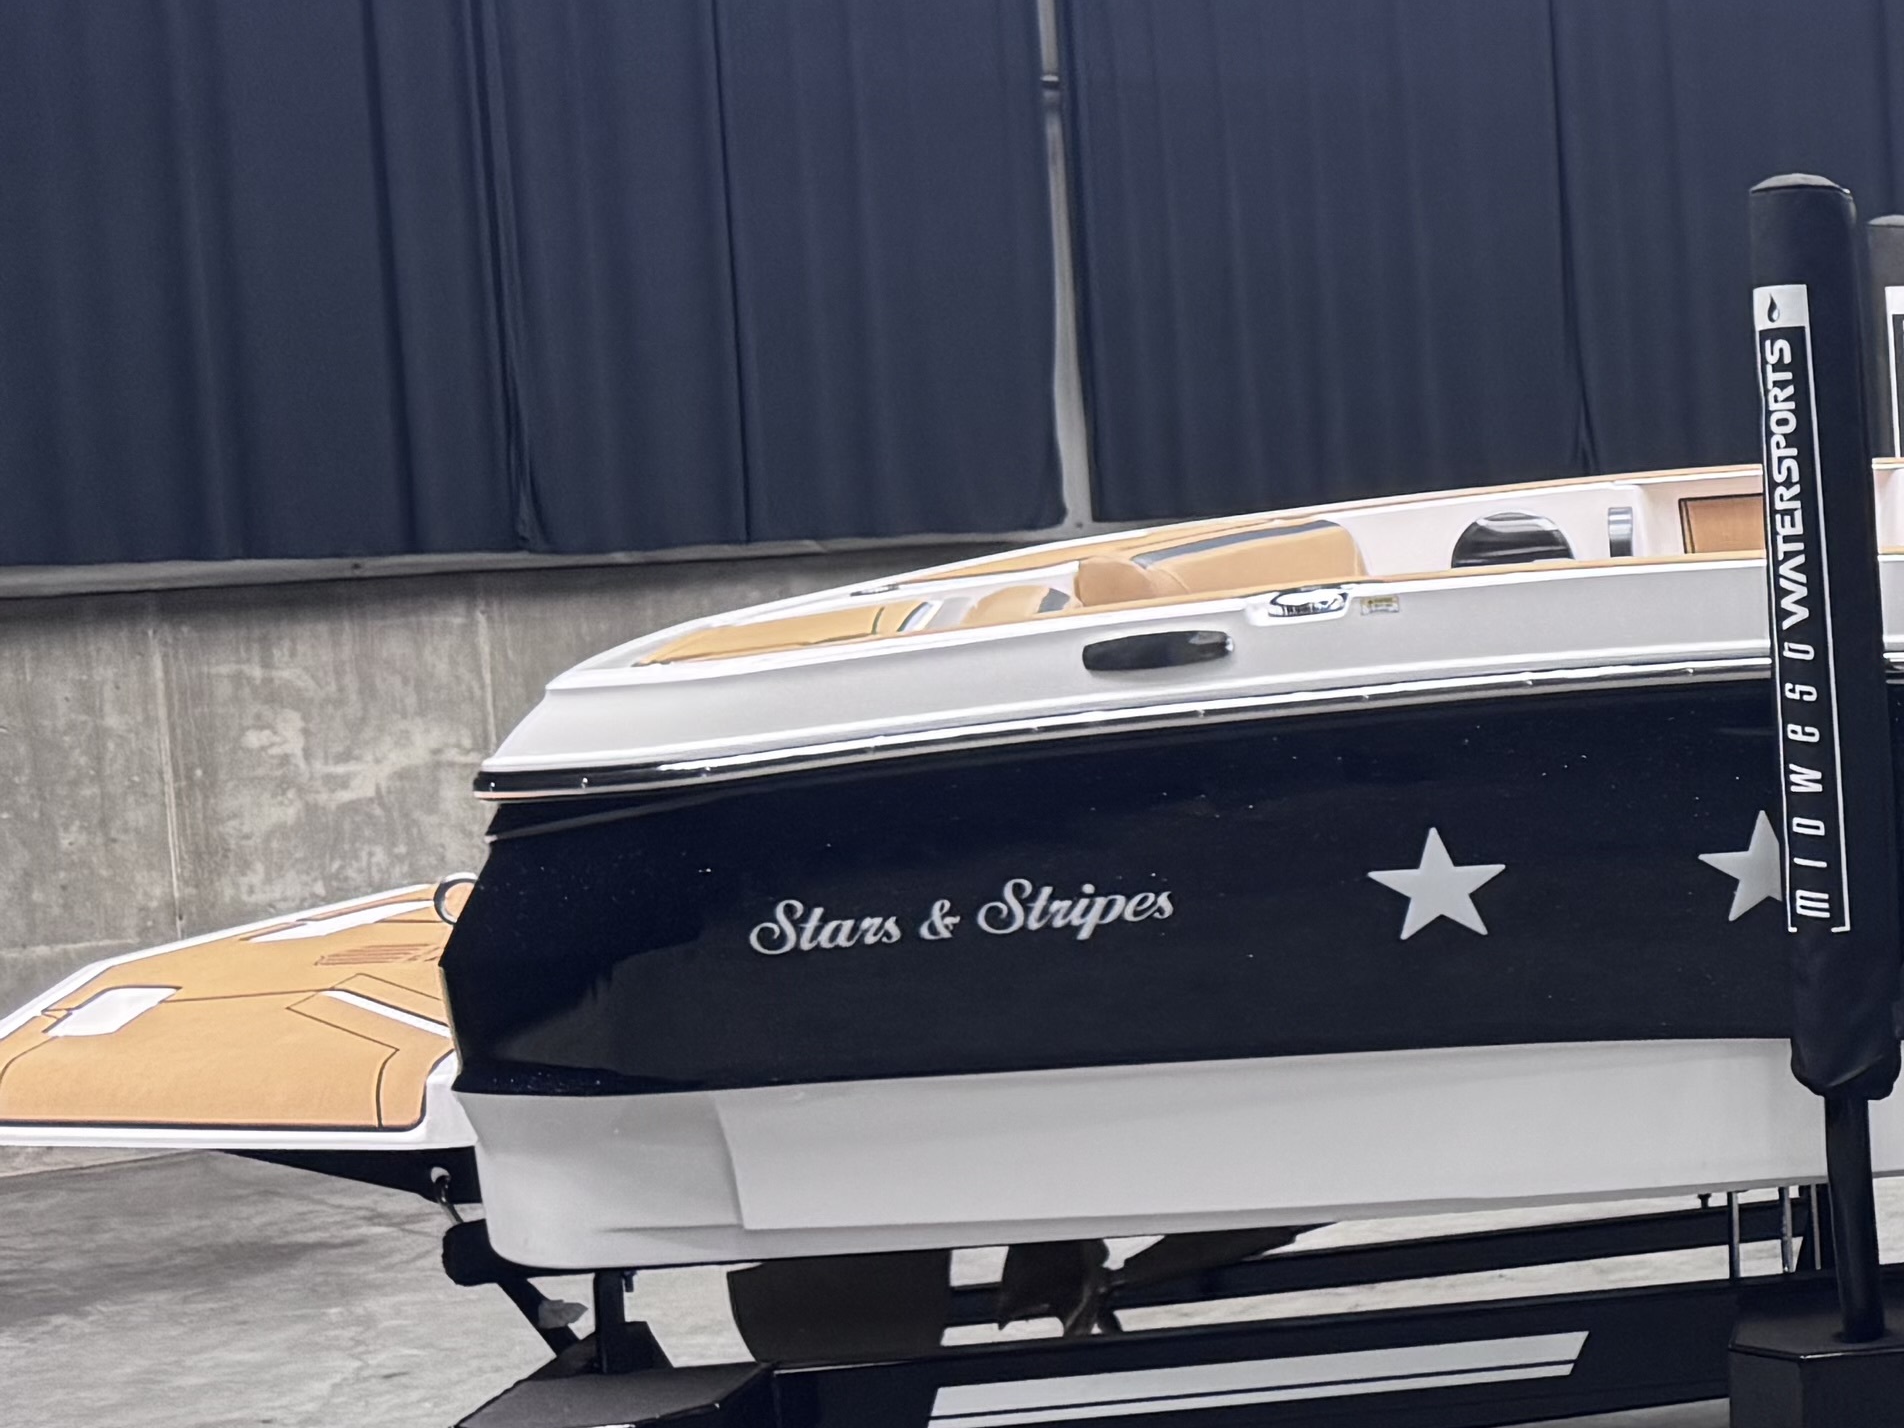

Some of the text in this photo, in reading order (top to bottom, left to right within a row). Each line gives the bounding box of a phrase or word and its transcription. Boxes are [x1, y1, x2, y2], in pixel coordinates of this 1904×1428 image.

[1764, 338, 1810, 631] WATERSPORTS
[746, 877, 1175, 956] Stars & Stripes
